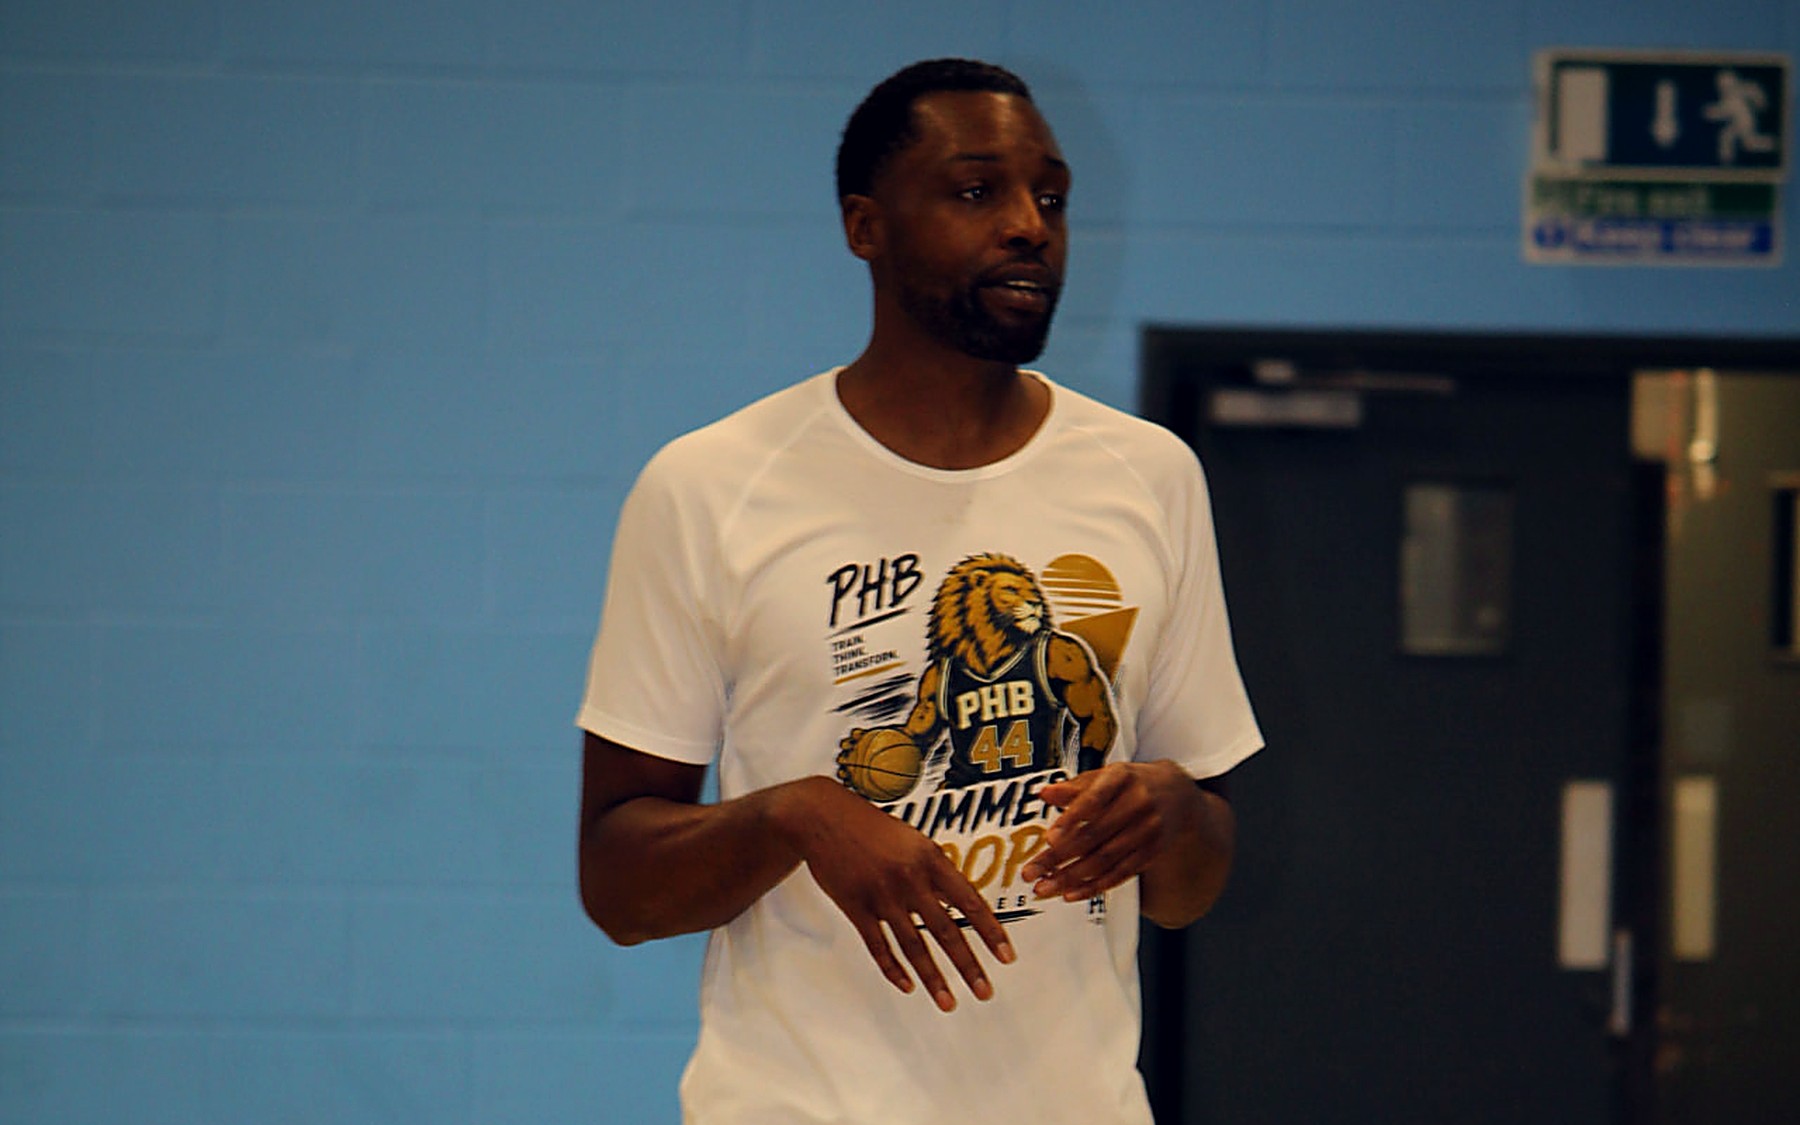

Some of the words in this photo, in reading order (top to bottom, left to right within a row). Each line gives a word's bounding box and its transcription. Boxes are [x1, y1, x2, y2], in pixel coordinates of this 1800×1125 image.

[827, 553, 923, 628] PHB
[956, 680, 1035, 730] PHB
[969, 719, 1034, 774] 44
[881, 771, 1068, 838] UMMER
